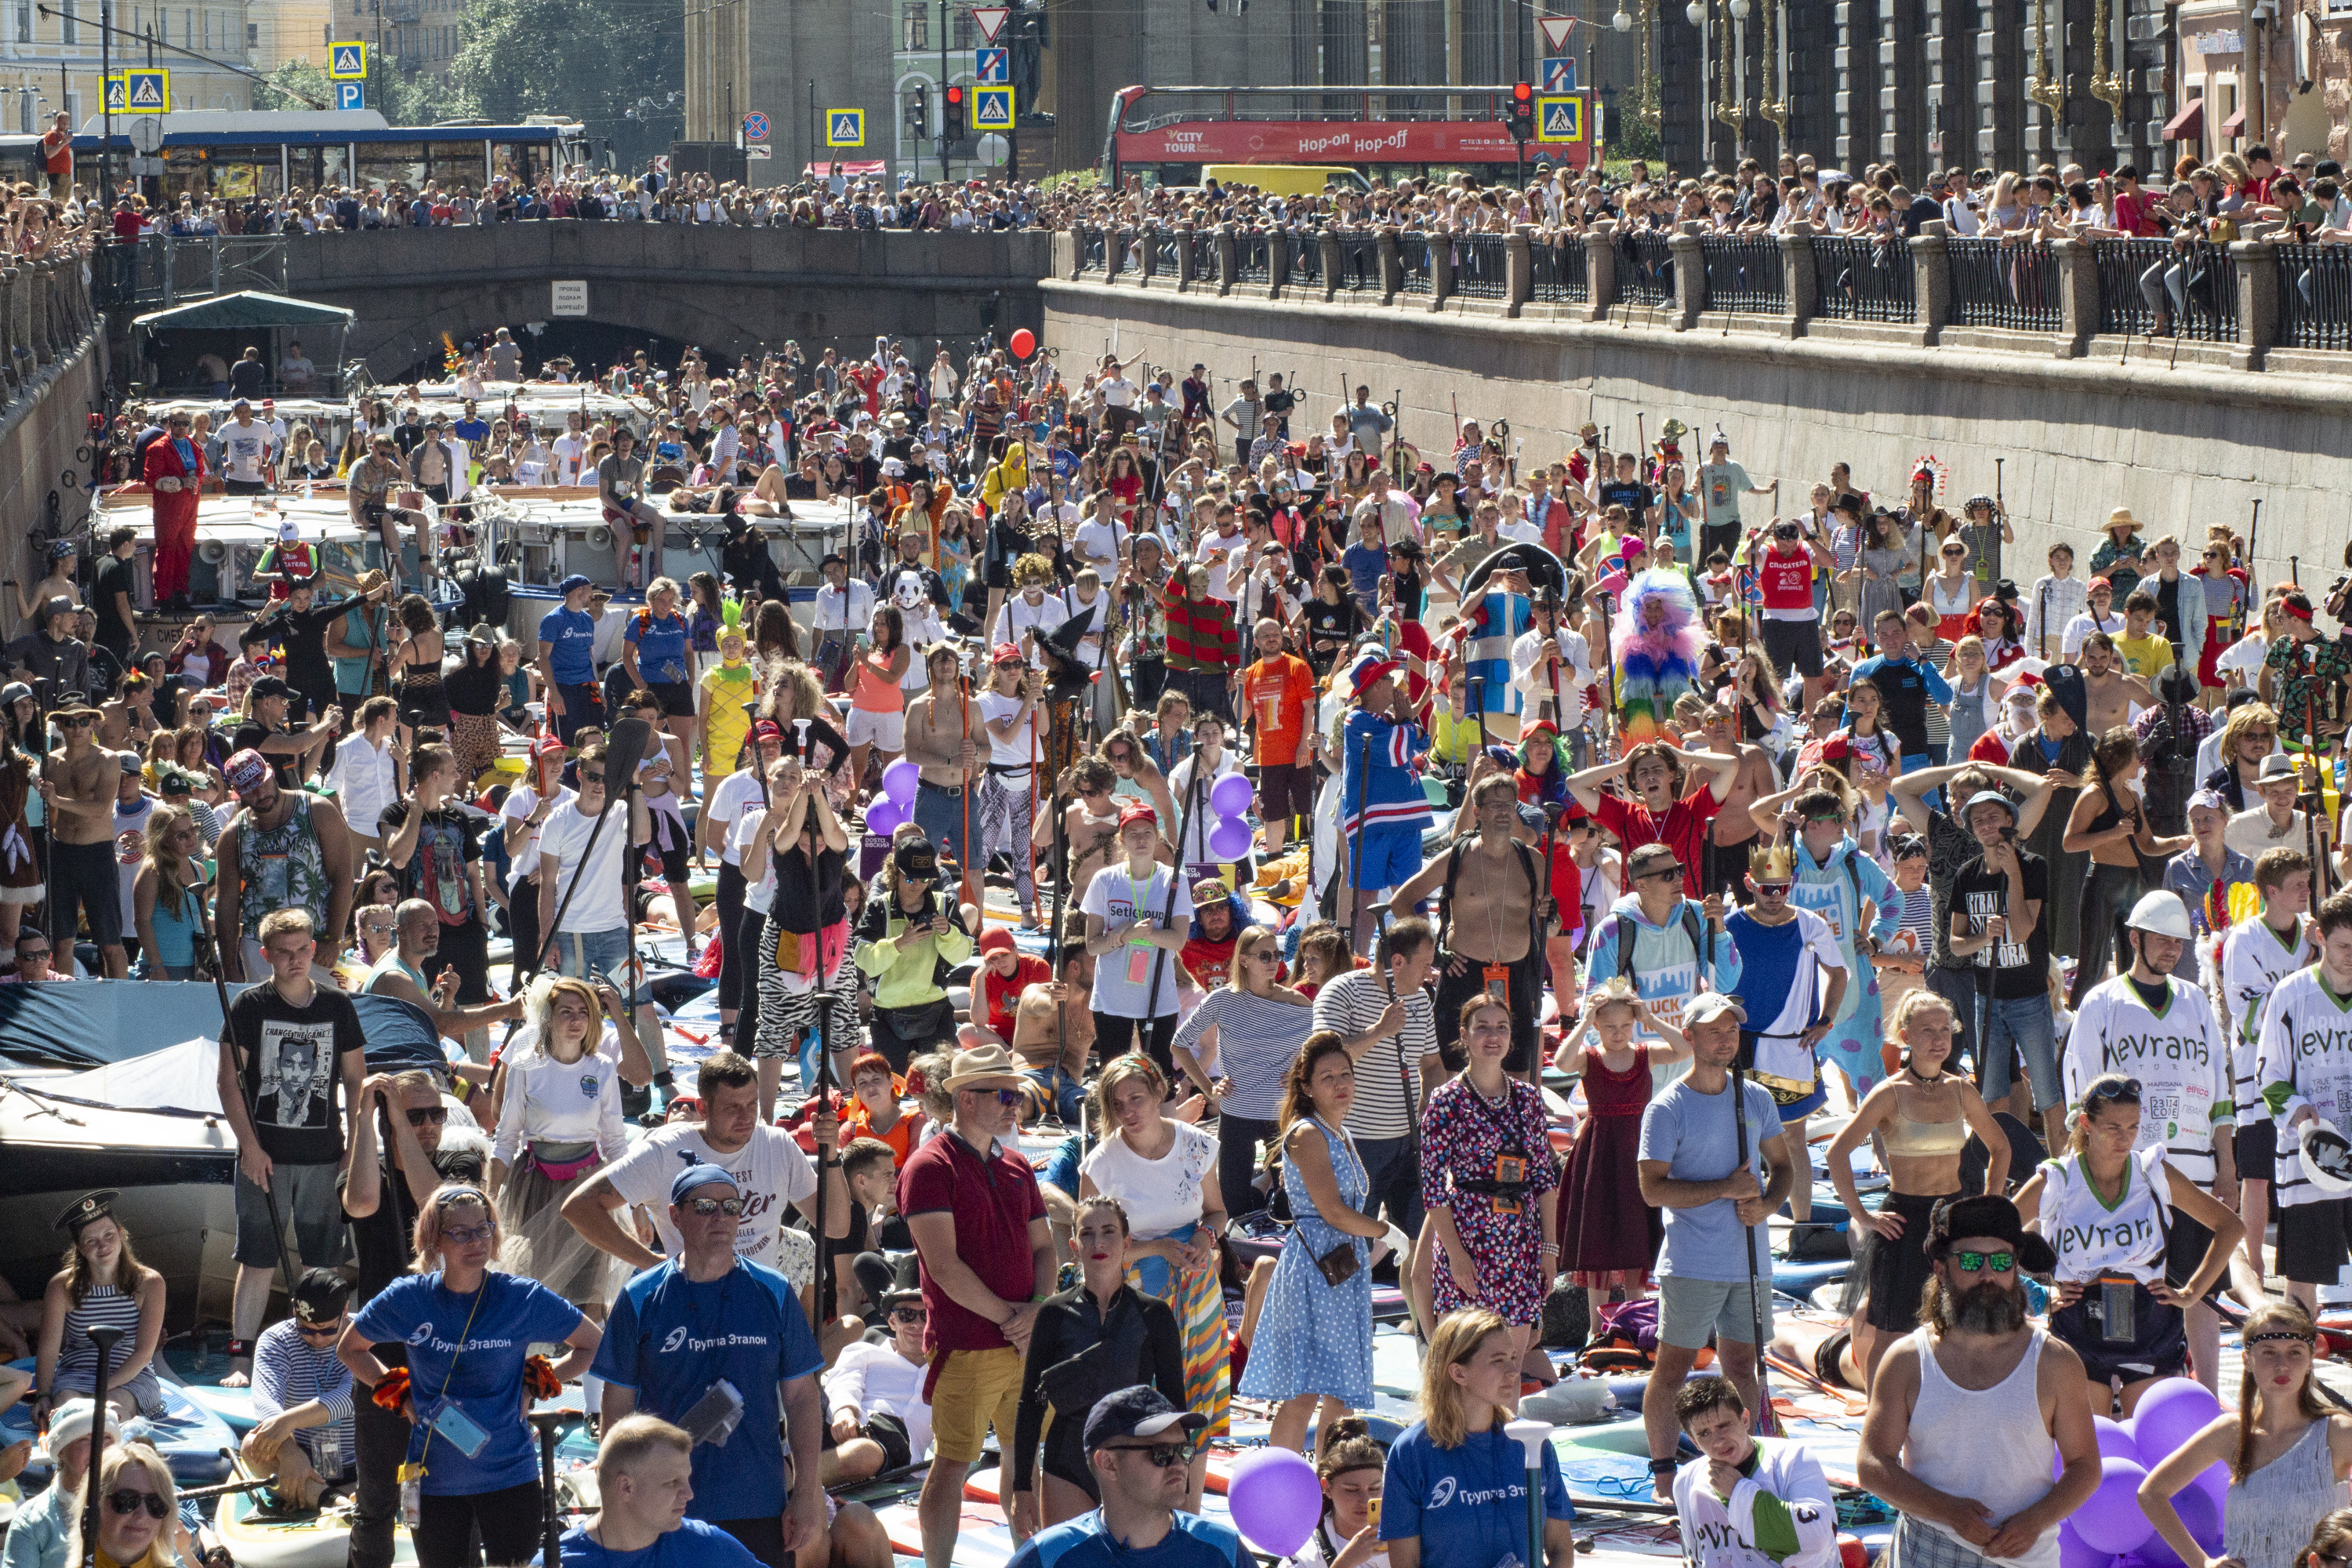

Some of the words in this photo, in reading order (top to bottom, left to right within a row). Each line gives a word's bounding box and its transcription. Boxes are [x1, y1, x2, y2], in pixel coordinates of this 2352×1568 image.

[343, 85, 359, 108] P
[1177, 132, 1203, 142] CITY
[1298, 132, 1350, 153] Hop-on
[1355, 129, 1408, 154] Hop-off
[1164, 143, 1196, 152] TOUR
[1769, 559, 1808, 569] СПАСАТЕЛЬ
[239, 764, 260, 783] JAPAN
[250, 836, 309, 866] MIAMI
[265, 1028, 292, 1037] CHANGE
[2142, 1132, 2162, 1141] CARE
[469, 1338, 511, 1350] Эталон
[728, 1334, 767, 1345] Эталон
[1459, 1489, 1506, 1505] Группа
